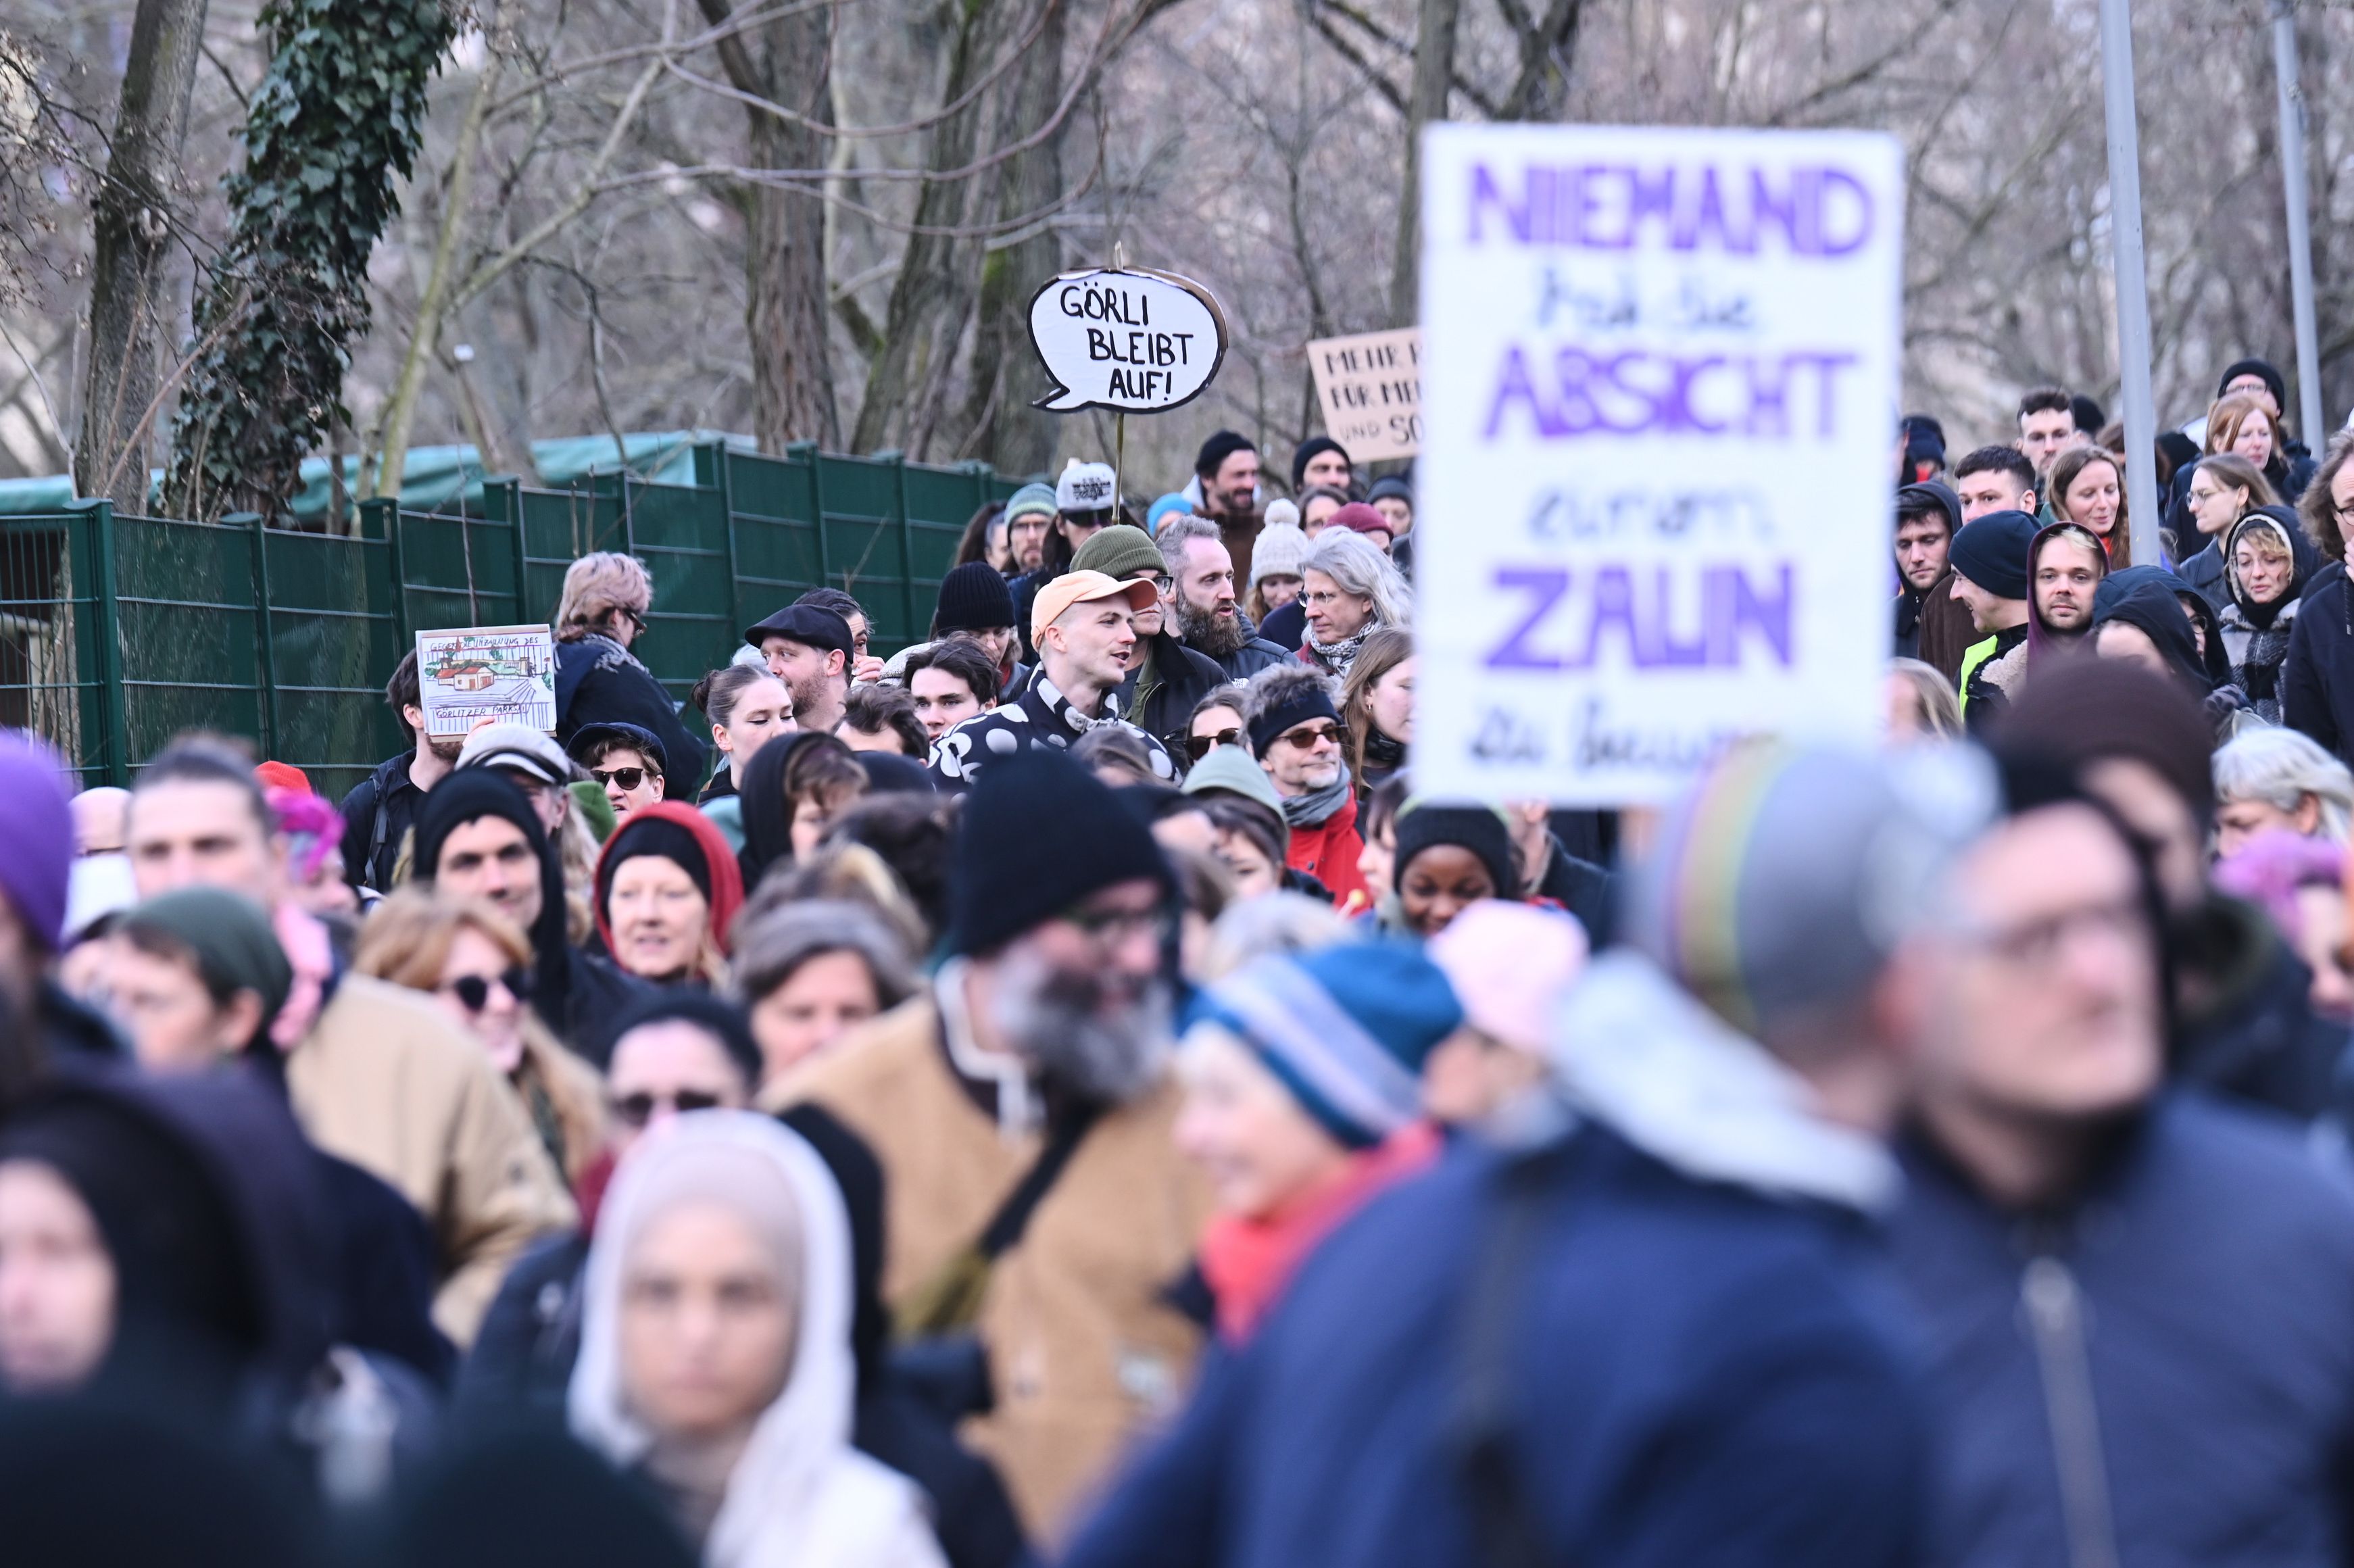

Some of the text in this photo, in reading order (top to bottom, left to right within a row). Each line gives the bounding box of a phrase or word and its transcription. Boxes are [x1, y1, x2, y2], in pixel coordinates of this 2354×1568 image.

[1468, 162, 1875, 255] NIEMAND
[1060, 281, 1149, 326] GÖRLI
[1087, 328, 1194, 366] BLEIBT
[1325, 345, 1404, 375] MEHR
[1109, 368, 1172, 401] AUF!
[1484, 346, 1858, 438] ABSICHT
[1339, 420, 1380, 442] UND
[1486, 566, 1794, 669] ZAUN
[524, 636, 539, 645] DES
[436, 707, 486, 718] GÖRLITZER
